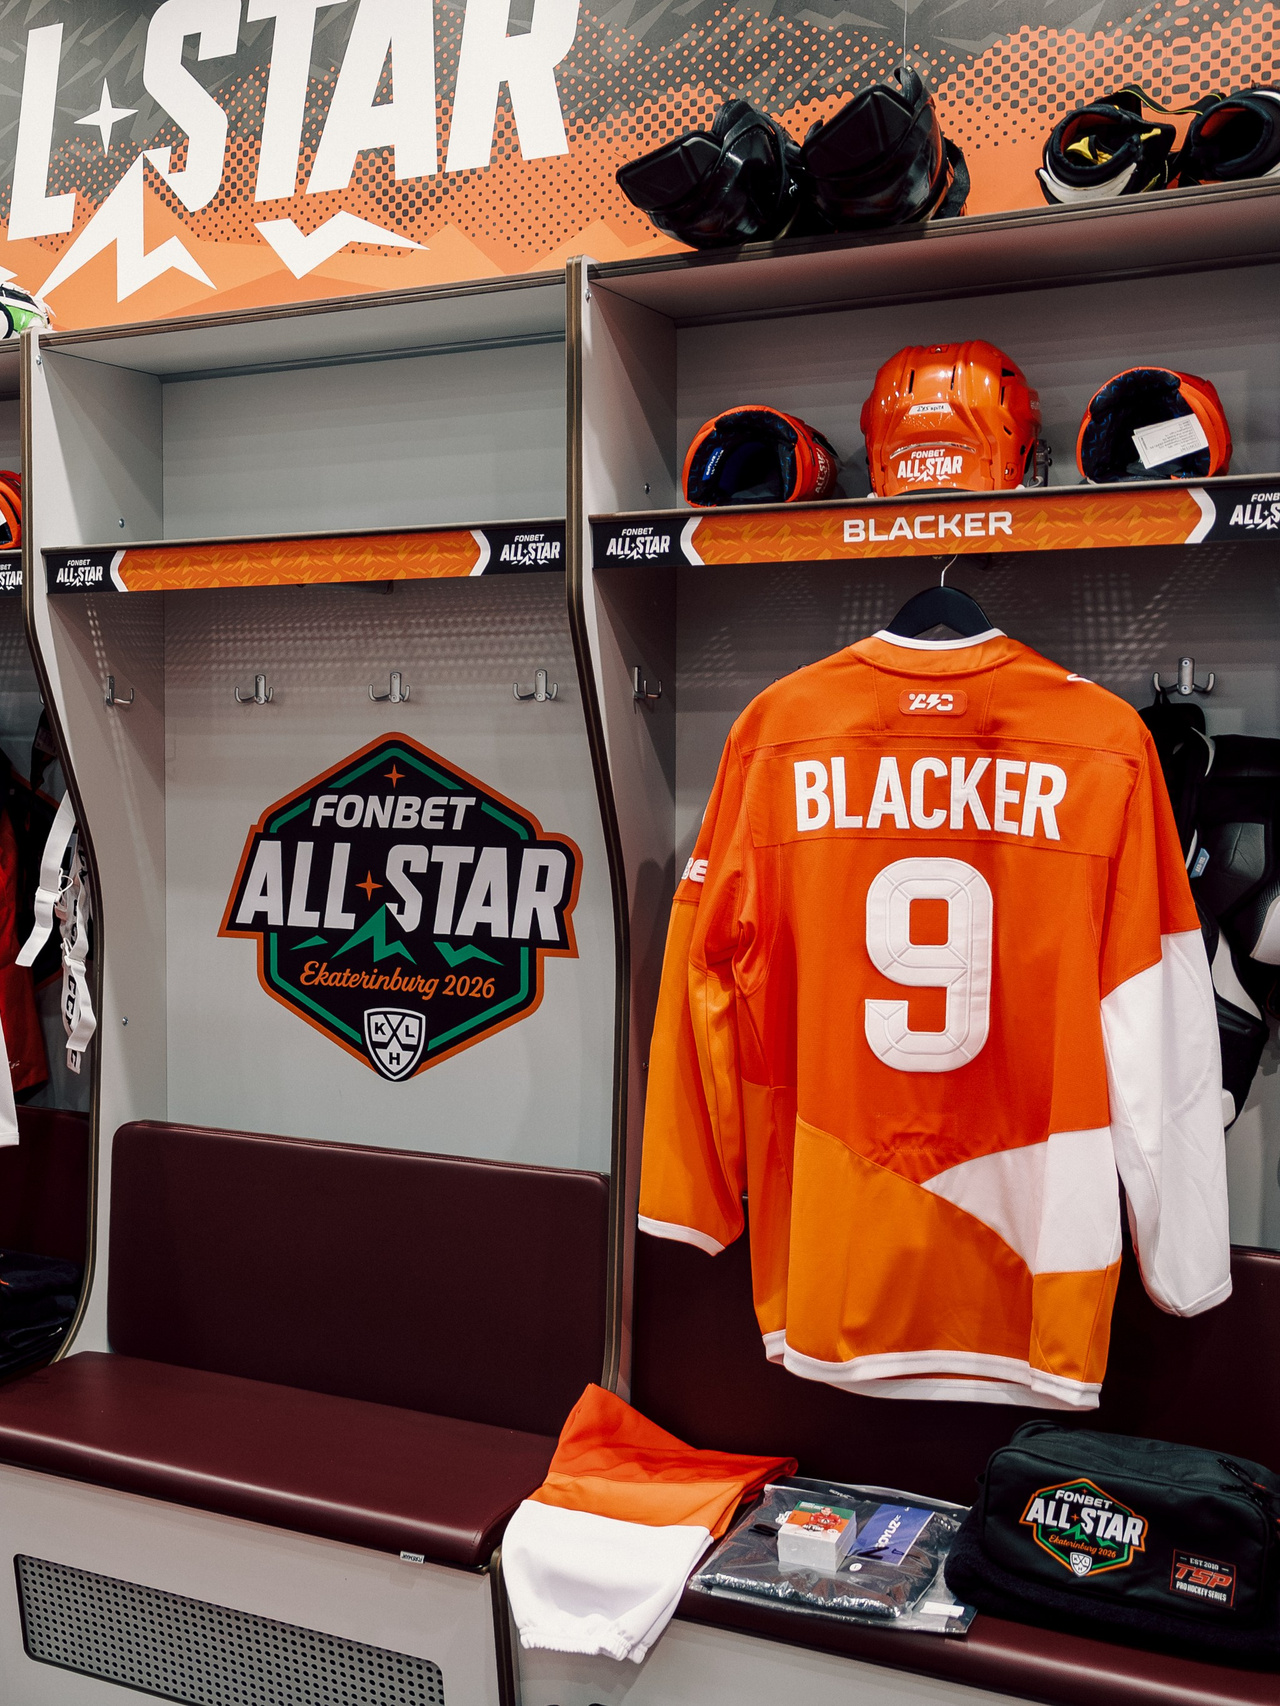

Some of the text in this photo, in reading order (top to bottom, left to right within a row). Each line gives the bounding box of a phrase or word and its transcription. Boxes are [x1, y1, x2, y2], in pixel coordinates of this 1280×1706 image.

[143, 0, 580, 213] STAR
[910, 448, 946, 460] FONBET
[896, 455, 963, 479] ALL STAR
[1250, 492, 1280, 502] FONB
[1229, 503, 1263, 525] ALL
[514, 533, 545, 542] FONBET
[621, 527, 654, 536] FONBET
[843, 511, 1013, 543] BLACKER
[500, 541, 561, 561] ALL STAR
[606, 535, 670, 556] ALL STAR
[0, 571, 23, 585] STAR
[56, 566, 103, 583] ALL STAR
[793, 756, 1068, 841] BLACKER
[311, 794, 477, 831] FONBET
[234, 839, 568, 942] ALL STAR
[864, 856, 994, 1073] 9
[299, 960, 496, 1001] Ekaterinburg 2026
[1055, 1489, 1113, 1510] FONBET
[1025, 1497, 1144, 1546] ALL STAR
[1048, 1534, 1117, 1559] Ekaterinburg 2026
[1175, 1563, 1233, 1588] TSP
[1176, 1580, 1227, 1602] PRO HOCKEY SERIES
